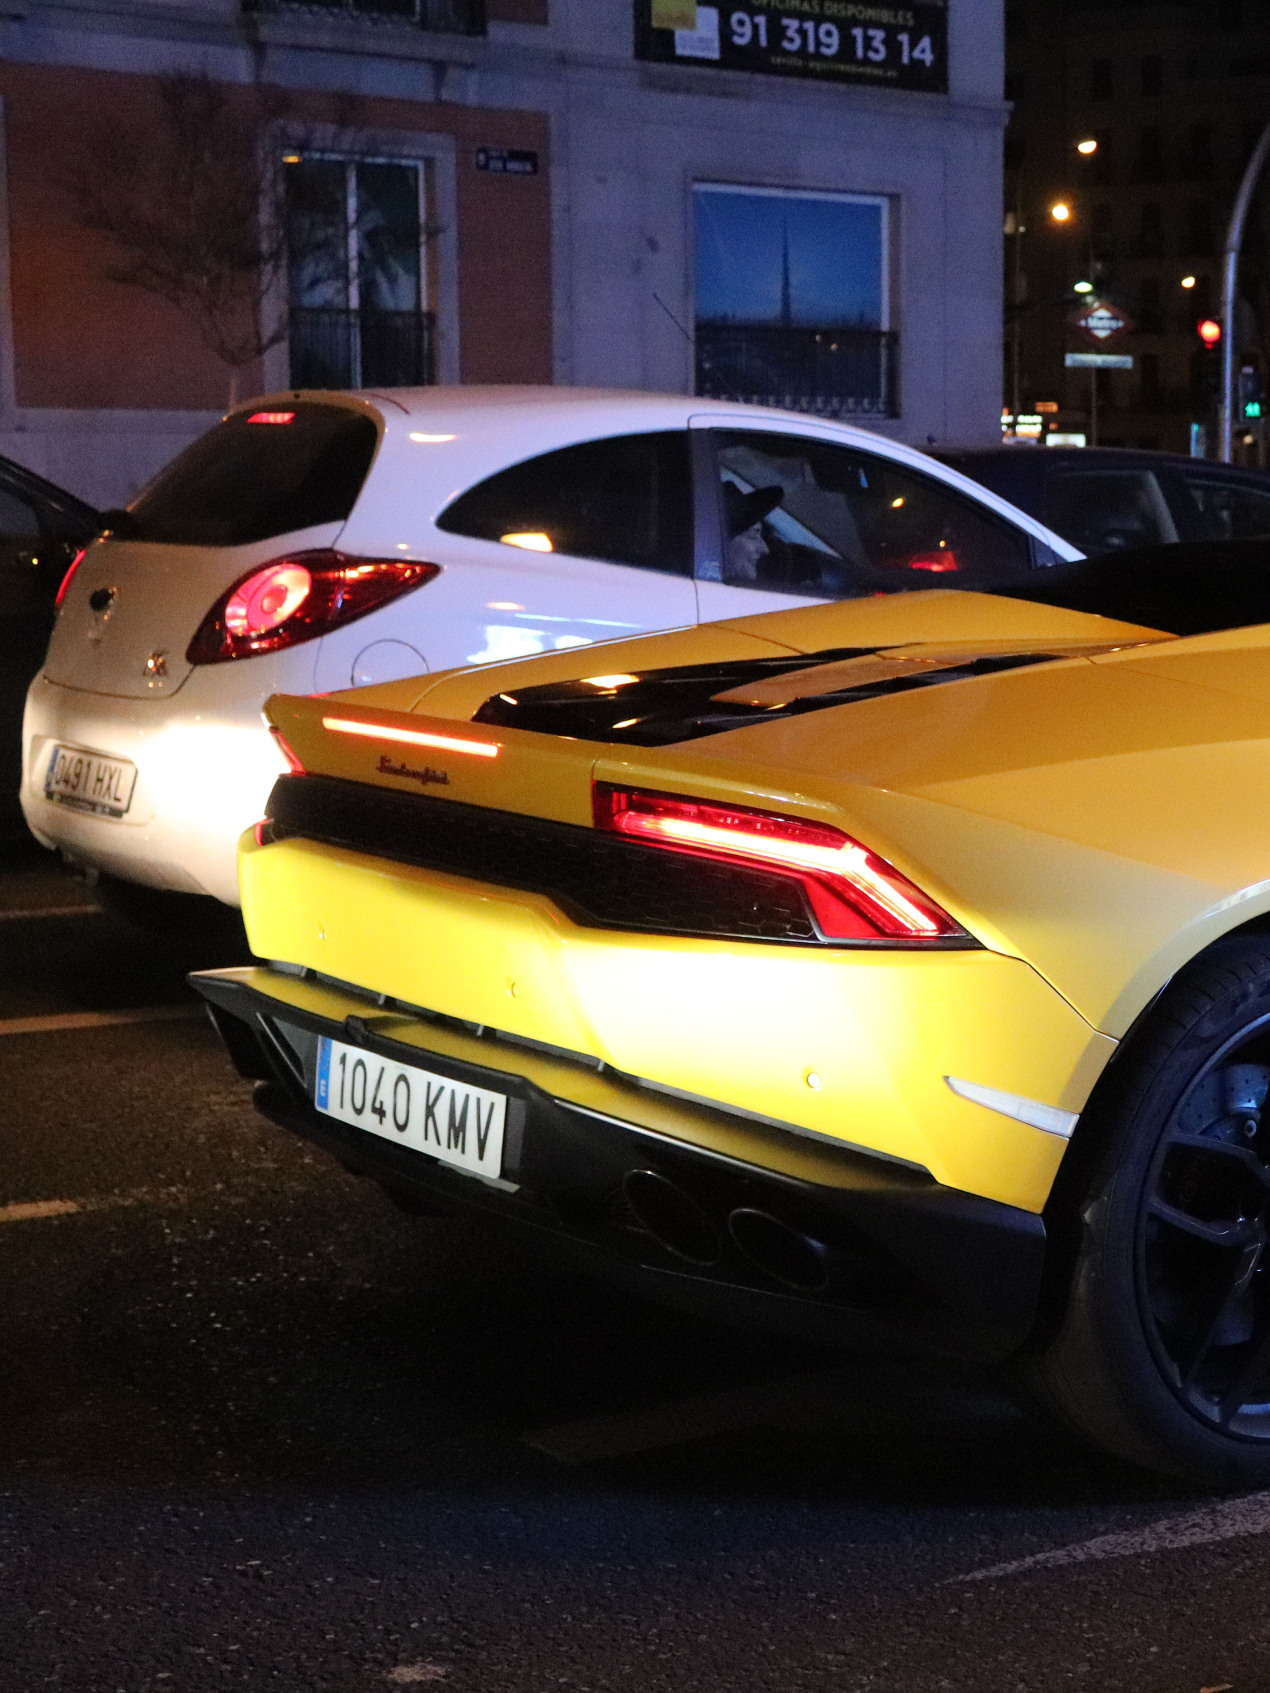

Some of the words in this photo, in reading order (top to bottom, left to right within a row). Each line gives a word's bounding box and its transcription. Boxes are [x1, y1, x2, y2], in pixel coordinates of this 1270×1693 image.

[730, 11, 768, 48] 91
[781, 18, 840, 56] 319
[851, 27, 887, 62] 13
[897, 32, 934, 67] 14
[823, 1, 914, 27] DISPONIBLES
[55, 754, 92, 792] 0491
[92, 762, 122, 802] HXL
[338, 1052, 412, 1133] 1040
[423, 1081, 496, 1162] KMV
